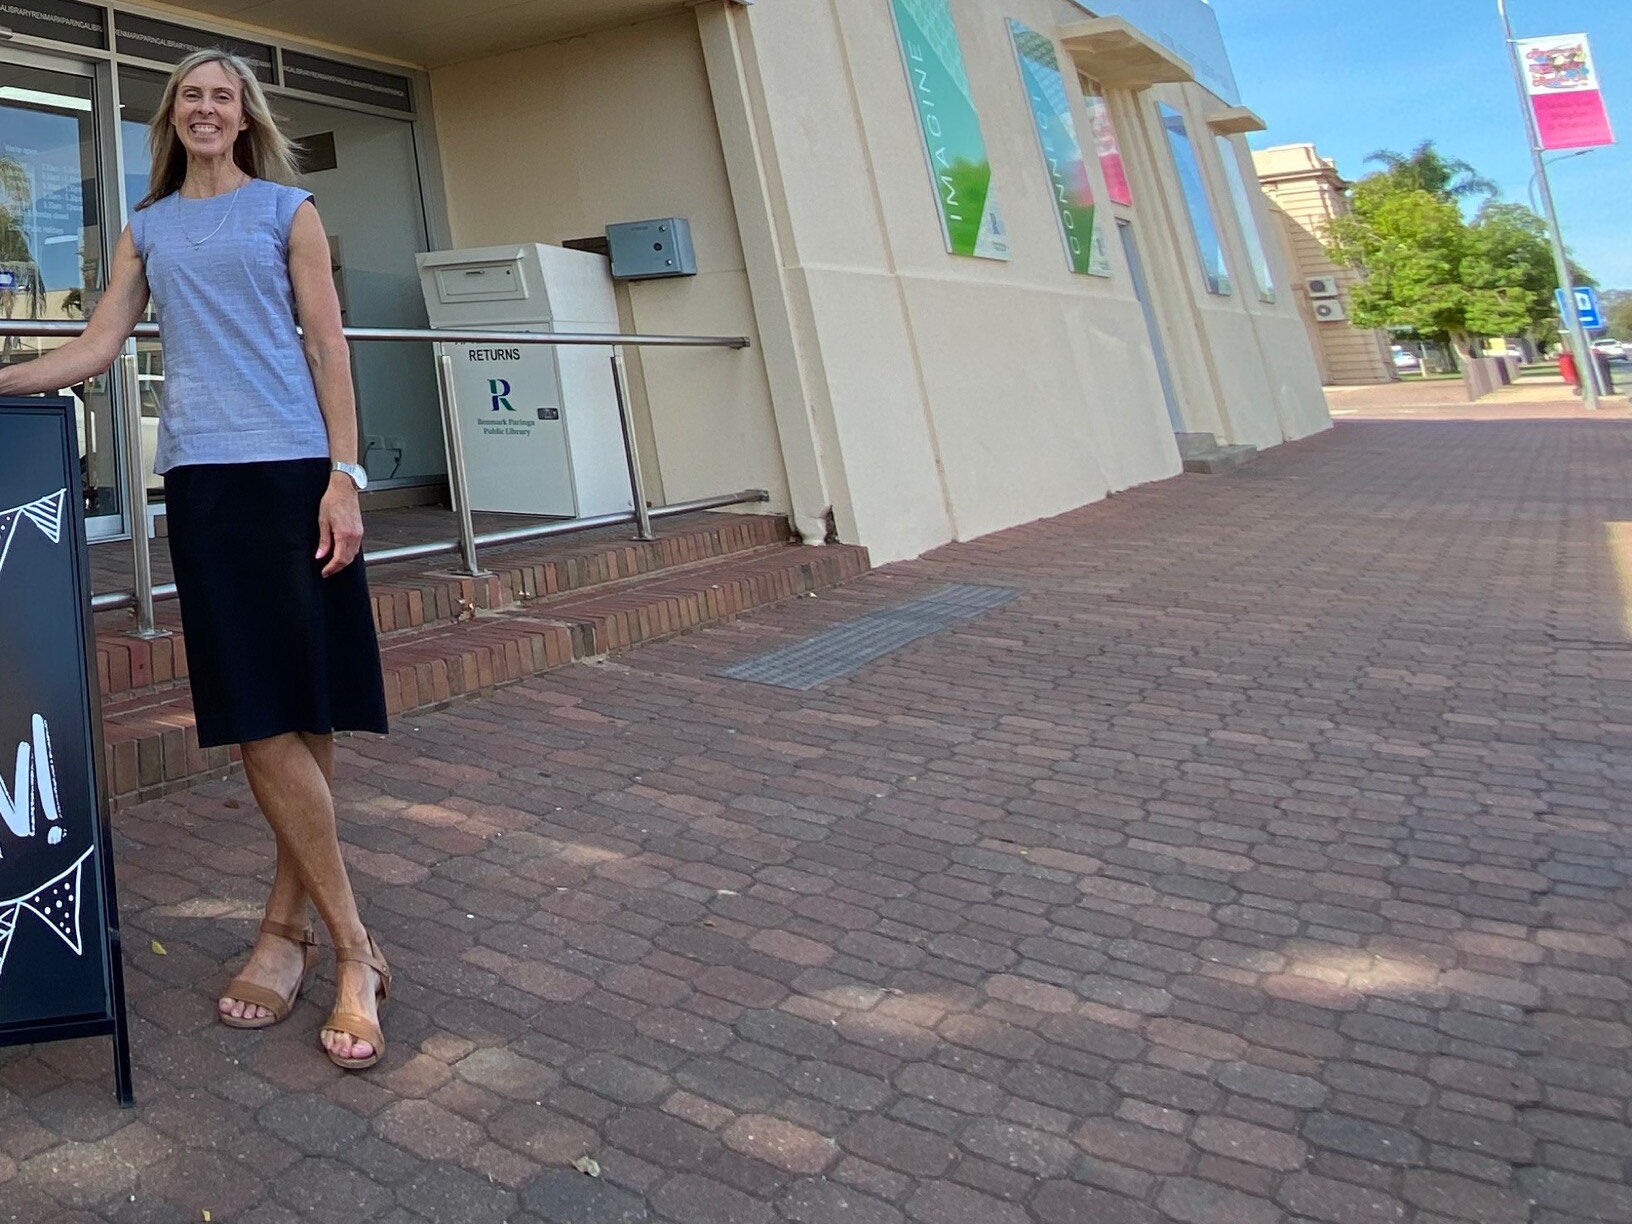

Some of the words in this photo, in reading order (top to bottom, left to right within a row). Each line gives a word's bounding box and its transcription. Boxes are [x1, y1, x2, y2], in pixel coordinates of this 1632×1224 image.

[909, 40, 963, 223] IMAGINE
[469, 348, 521, 362] RETURNS
[477, 418, 507, 426] Renmark
[508, 418, 536, 427] Paringa
[505, 428, 531, 437] Library
